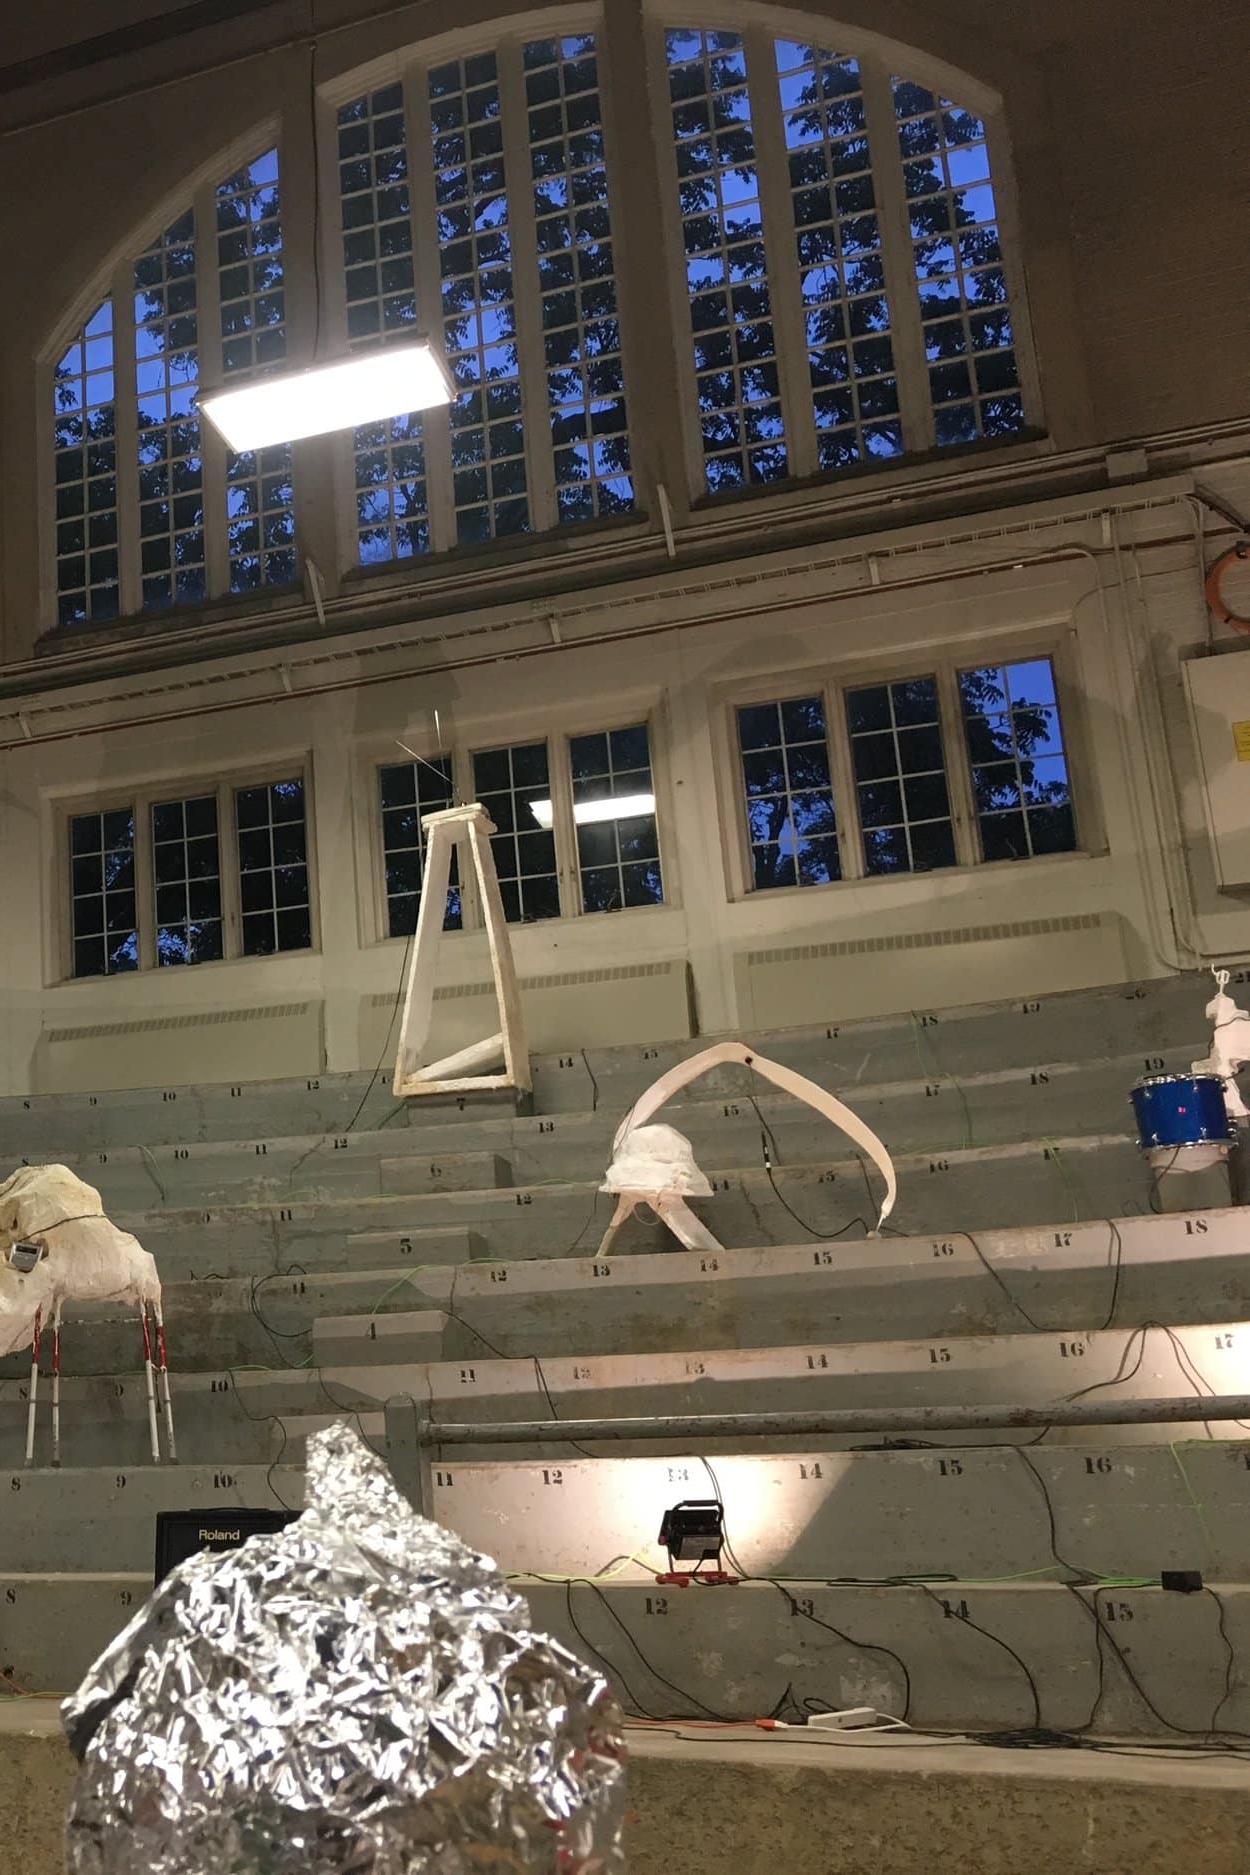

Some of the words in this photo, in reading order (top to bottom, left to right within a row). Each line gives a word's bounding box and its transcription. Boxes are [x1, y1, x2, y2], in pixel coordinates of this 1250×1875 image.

[1022, 1003, 1040, 1015] 19
[922, 1016, 938, 1028] 18
[827, 1028, 840, 1040] 17
[558, 1057, 573, 1069] 14
[1144, 1058, 1164, 1071] 19
[307, 1079, 319, 1091] 12
[1031, 1073, 1048, 1086] 18
[162, 1091, 176, 1103] 10
[230, 1087, 242, 1098] 11
[925, 1085, 940, 1097] 17
[22, 1099, 31, 1111] 8
[456, 1098, 467, 1111] 7
[724, 1105, 738, 1117] 15
[538, 1121, 554, 1133] 13
[255, 1143, 267, 1155] 11
[334, 1138, 348, 1150] 12
[99, 1153, 108, 1164] 9
[174, 1149, 189, 1161] 10
[929, 1161, 949, 1174] 16
[516, 1194, 531, 1206] 12
[281, 1209, 292, 1221] 11
[1184, 1219, 1208, 1234] 18
[400, 1238, 412, 1254] 5
[1054, 1233, 1072, 1247] 17
[933, 1243, 953, 1257] 16
[814, 1252, 832, 1265] 15
[593, 1265, 610, 1277] 13
[1215, 1334, 1234, 1349] 17
[930, 1349, 950, 1363] 15
[1059, 1342, 1085, 1357] 16
[806, 1355, 828, 1369] 14
[211, 1380, 229, 1393] 10
[800, 1463, 822, 1479] 14
[938, 1460, 962, 1475] 15
[1084, 1457, 1112, 1473] 16
[115, 1475, 127, 1489] 9
[213, 1473, 232, 1489] 10
[437, 1472, 453, 1486] 11
[542, 1470, 562, 1484] 12
[10, 1478, 22, 1491] 8
[198, 1529, 240, 1541] Roland
[5, 1589, 17, 1604] 8
[121, 1591, 132, 1605] 9
[645, 1599, 667, 1615] 12
[790, 1600, 813, 1616] 13
[944, 1600, 969, 1618] 14
[1106, 1603, 1133, 1620] 15
